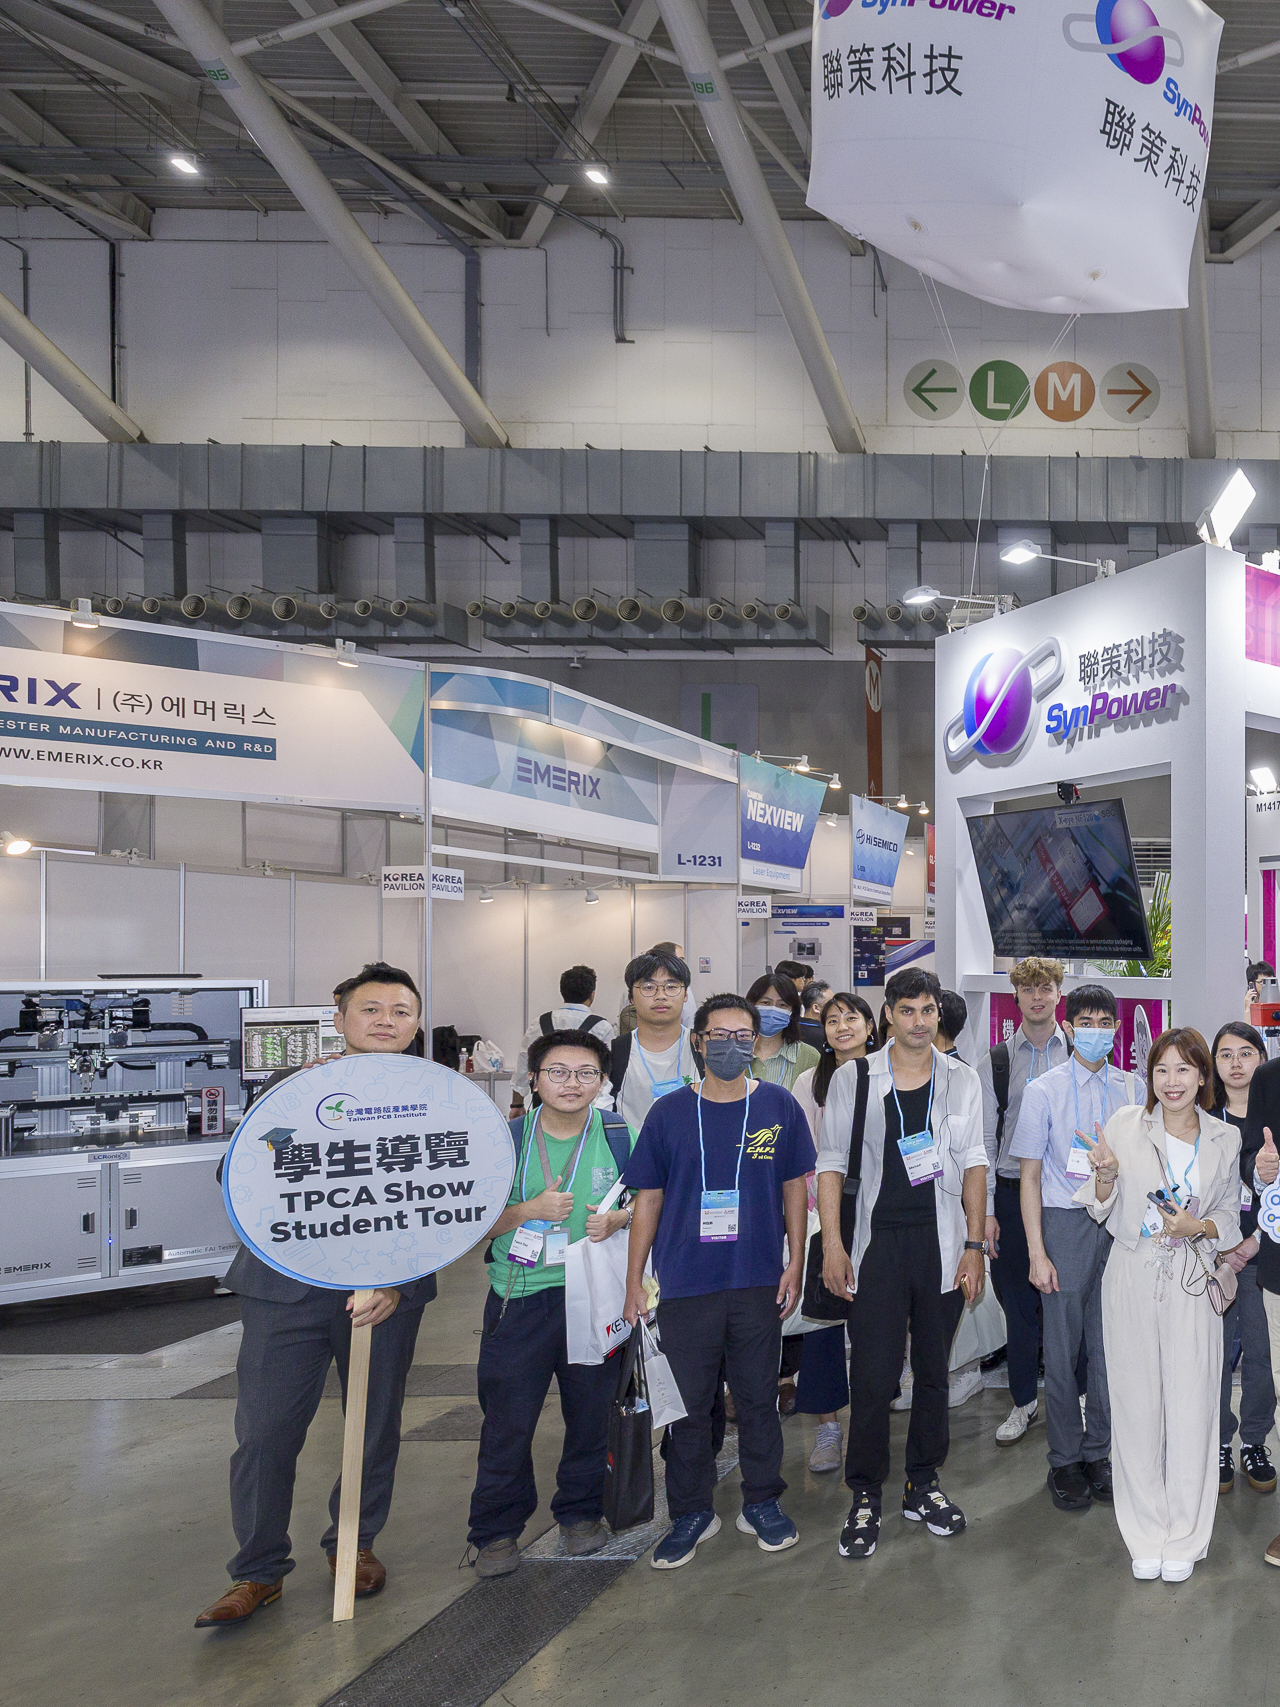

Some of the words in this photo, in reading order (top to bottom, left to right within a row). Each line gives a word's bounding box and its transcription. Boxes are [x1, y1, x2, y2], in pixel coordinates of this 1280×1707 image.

[822, 42, 963, 101] 聯策科技
[691, 81, 715, 94] 196
[1099, 97, 1201, 213] 聯策科技
[987, 370, 1011, 410] L
[1047, 372, 1082, 411] M
[1079, 628, 1175, 686] 聯策科技
[113, 690, 153, 716] (주)
[161, 695, 277, 727] 에머릭스
[1045, 683, 1177, 739] SynPower
[59, 725, 198, 747] MANUFACTURING
[205, 738, 236, 751] AND
[243, 742, 274, 754] R&D
[516, 756, 601, 801] EMERIX
[747, 799, 805, 833] NEXVIEW
[676, 853, 723, 868] L-1231
[752, 866, 766, 876] Laser
[766, 868, 791, 881] Equipment
[383, 872, 425, 884] KOREA
[383, 883, 426, 893] PAVILION
[431, 883, 464, 895] PAVILION
[432, 873, 463, 885] KOREA
[737, 900, 768, 908] KOREA
[206, 1099, 218, 1131] 請勿攝影
[346, 1103, 428, 1117] 台灣電路板產業學院
[393, 1111, 427, 1119] Institute
[273, 1130, 470, 1184] 學生導覽
[279, 1186, 378, 1214] TPCA
[384, 1179, 475, 1204] Show
[269, 1211, 409, 1243] Student
[415, 1205, 487, 1229] Tour
[167, 1247, 203, 1257] Automatic
[204, 1245, 216, 1253] FAI
[217, 1243, 239, 1251] Tester
[4, 1261, 52, 1274] EMERIX
